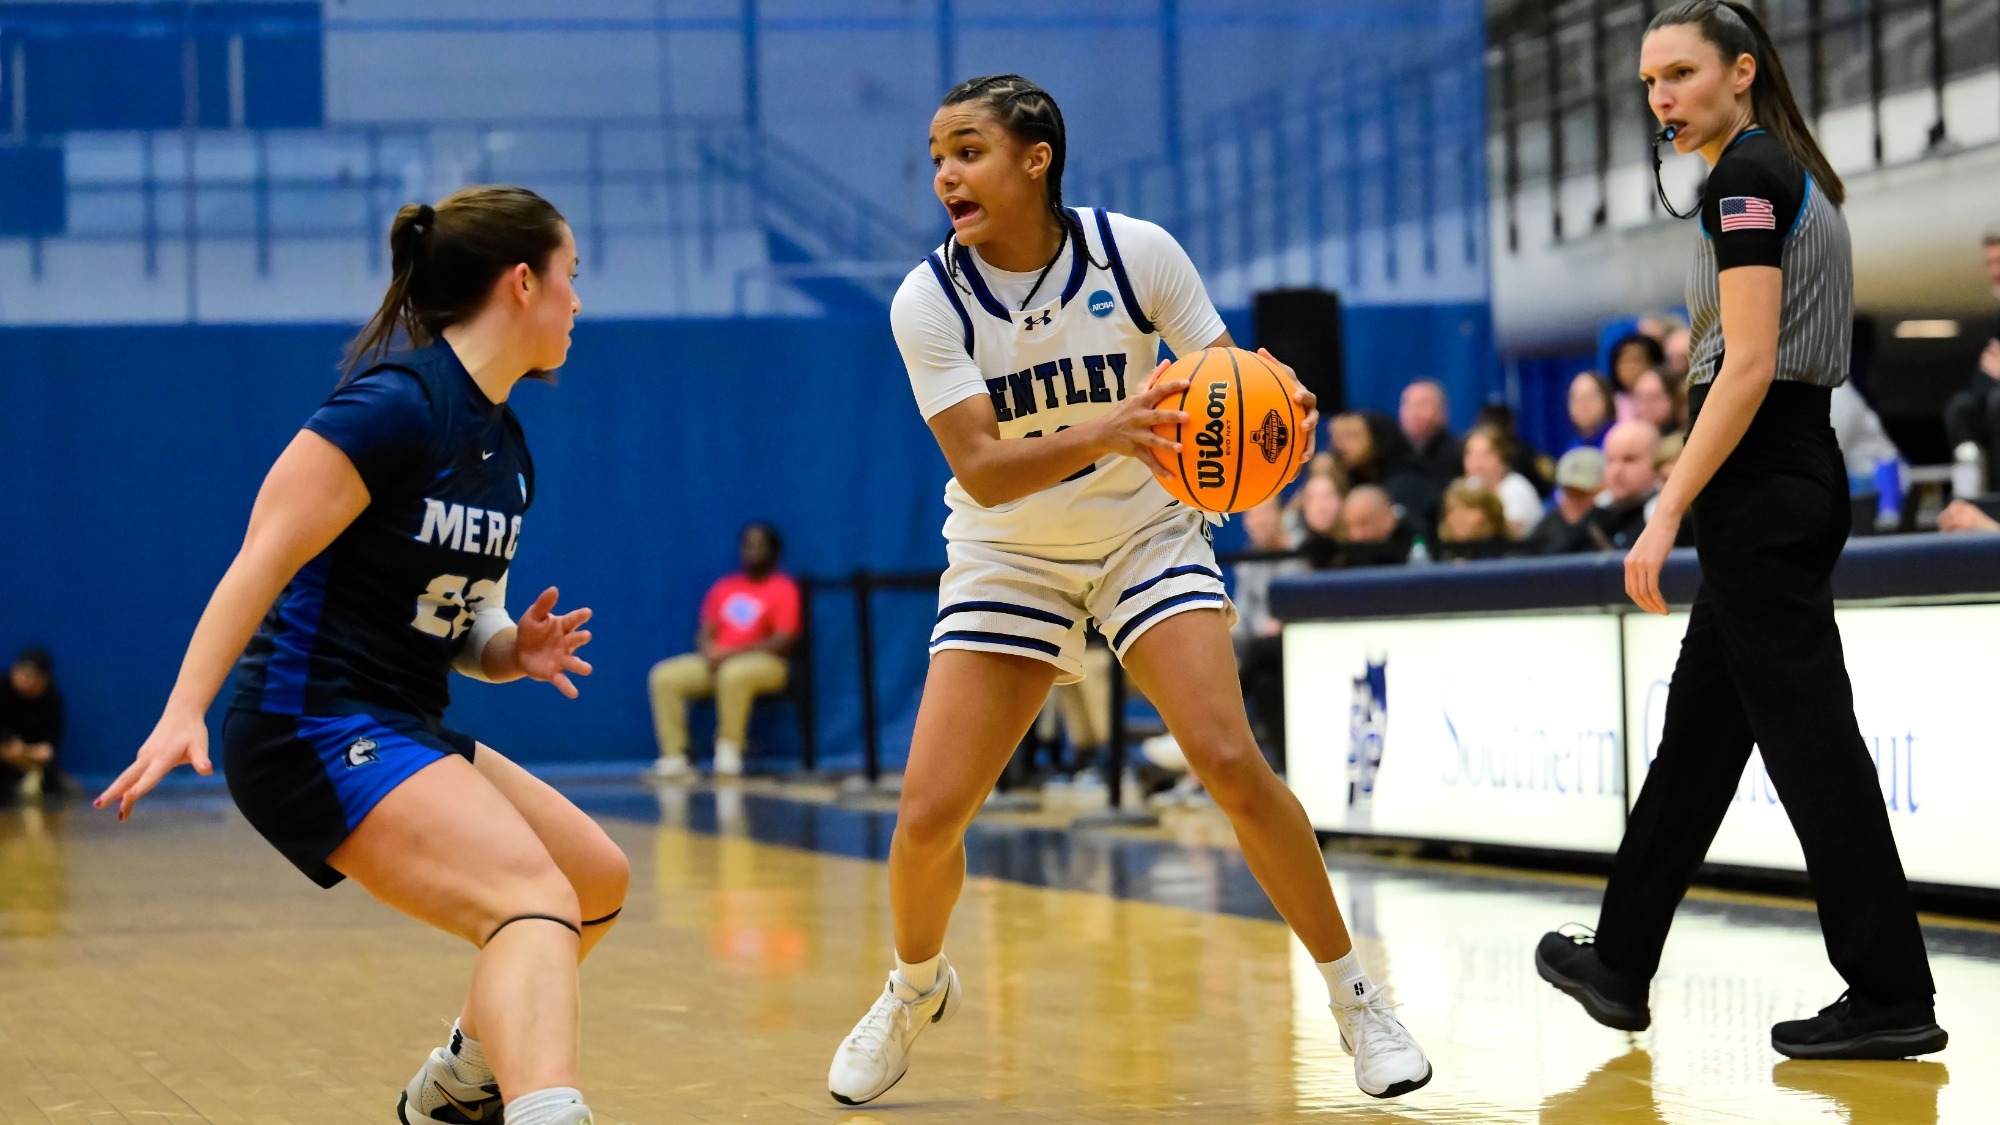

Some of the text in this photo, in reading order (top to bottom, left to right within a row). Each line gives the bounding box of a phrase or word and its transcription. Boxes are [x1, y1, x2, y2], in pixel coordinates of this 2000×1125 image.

[1092, 300, 1114, 312] NCAA
[985, 352, 1127, 422] ENTLEY
[1195, 380, 1229, 490] Wilson
[413, 497, 522, 560] MERC
